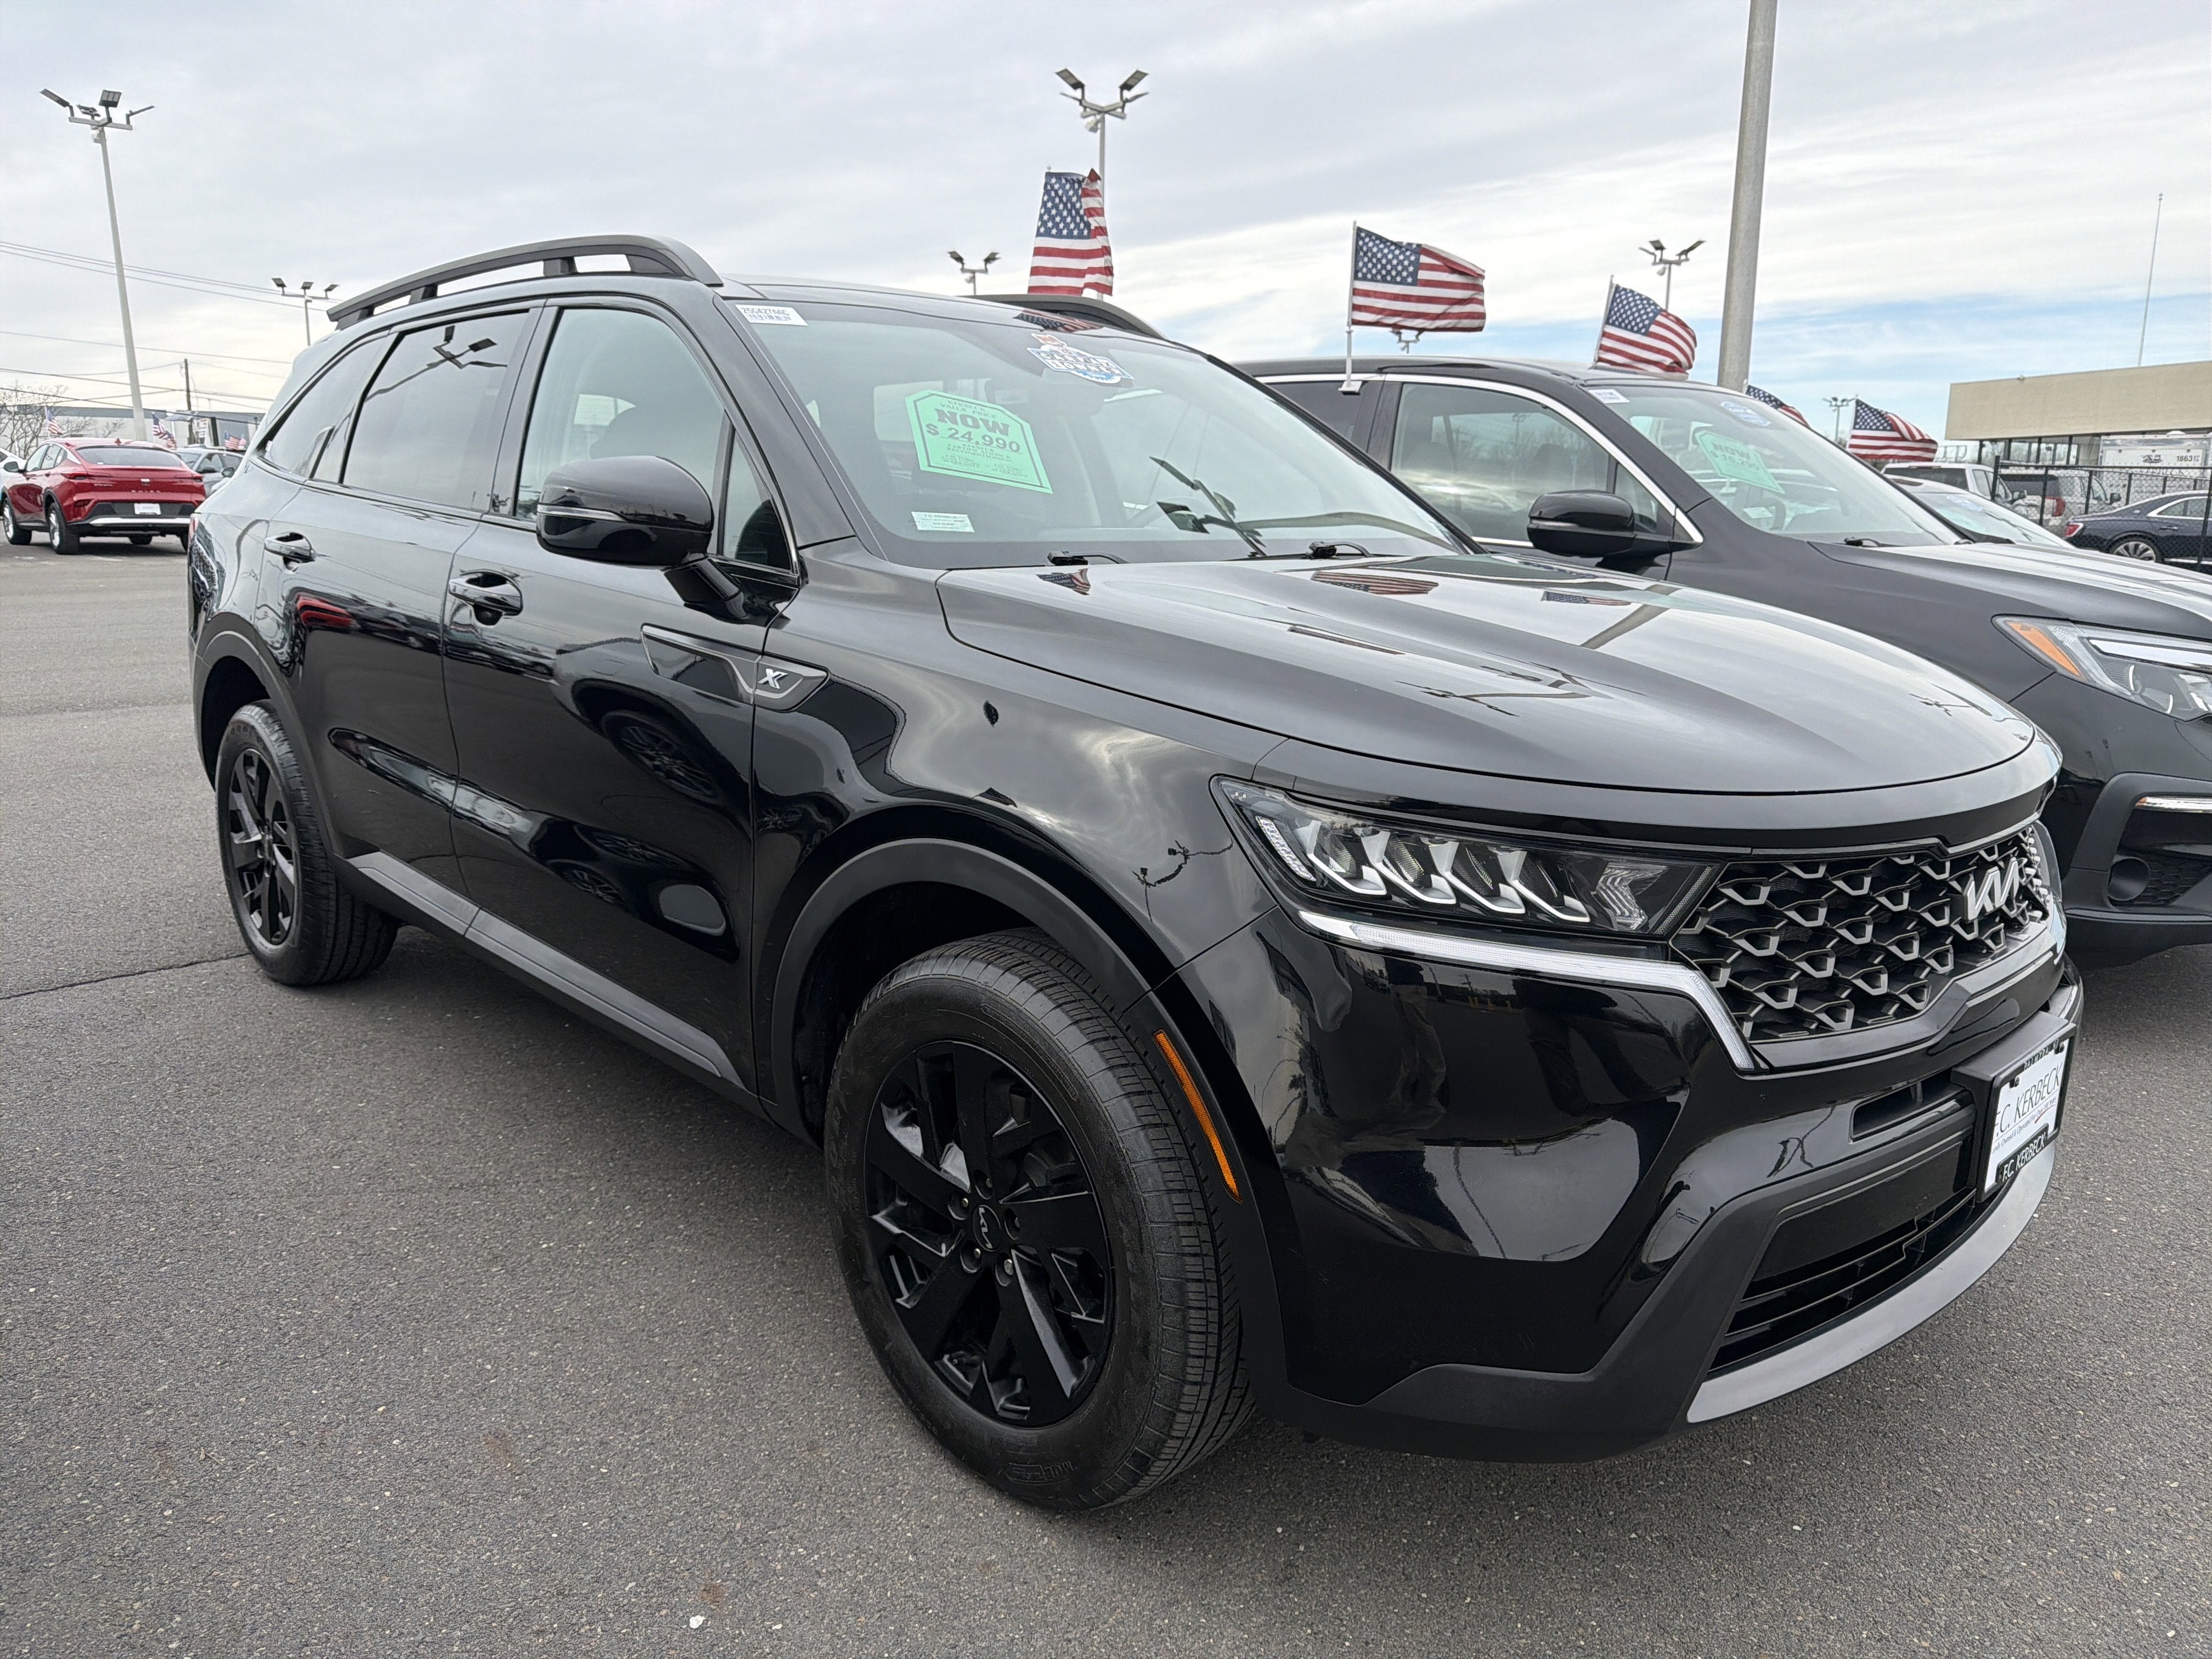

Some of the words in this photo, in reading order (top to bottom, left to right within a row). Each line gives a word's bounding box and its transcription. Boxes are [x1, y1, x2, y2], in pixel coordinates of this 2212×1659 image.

[1039, 352, 1115, 368] CARFAX
[1063, 362, 1123, 375] OWNER
[935, 408, 1009, 436] NOW
[940, 403, 966, 412] VALUE
[972, 410, 996, 419] PRICE
[926, 423, 939, 436] $
[947, 427, 1020, 453] 24,990
[1965, 857, 2019, 922] KIA
[2014, 1062, 2063, 1124] KERBECK
[2015, 1132, 2047, 1171] KERBECK
